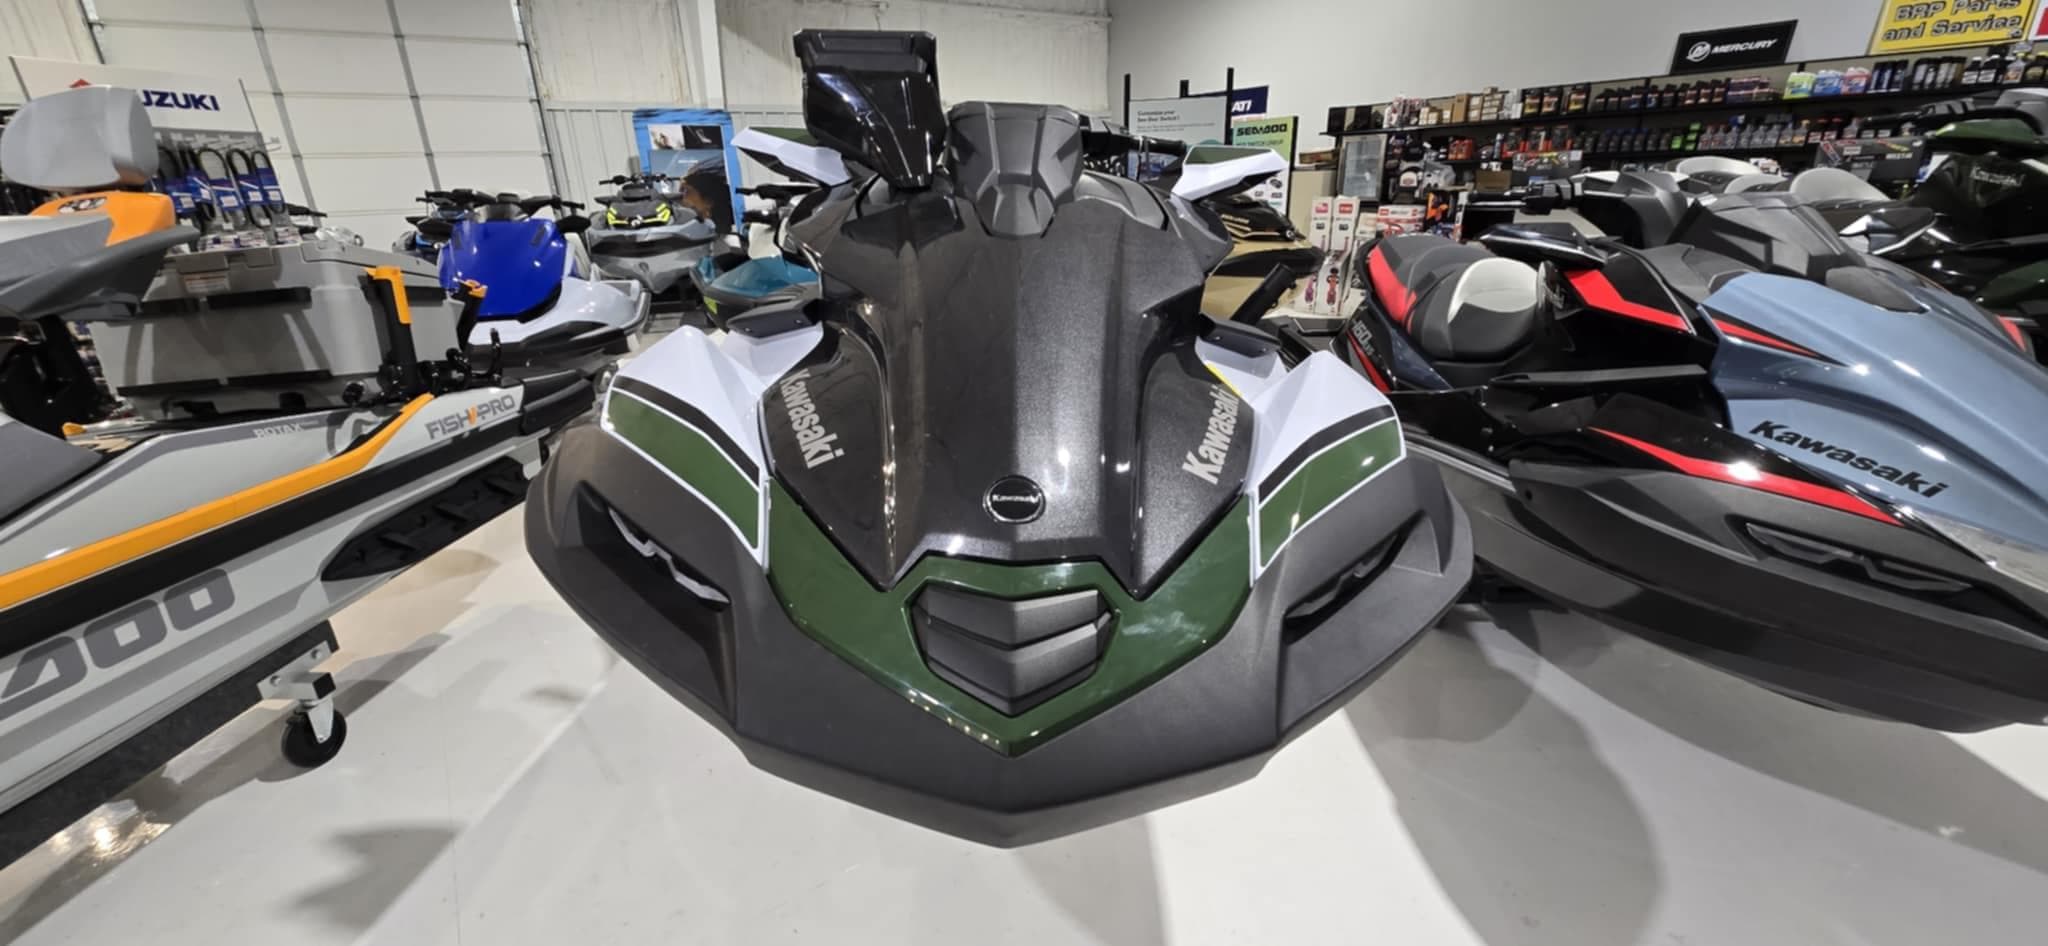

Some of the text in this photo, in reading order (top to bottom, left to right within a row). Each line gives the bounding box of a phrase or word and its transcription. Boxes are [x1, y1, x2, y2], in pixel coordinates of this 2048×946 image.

[1895, 1, 1945, 21] BRP
[1882, 15, 2022, 41] and Service
[1711, 39, 1778, 54] MERCURY
[780, 368, 844, 469] Kawasaki
[1182, 384, 1239, 485] Kawasaki
[1749, 420, 1949, 498] Kawasaki
[992, 493, 1041, 504] Kawasaki
